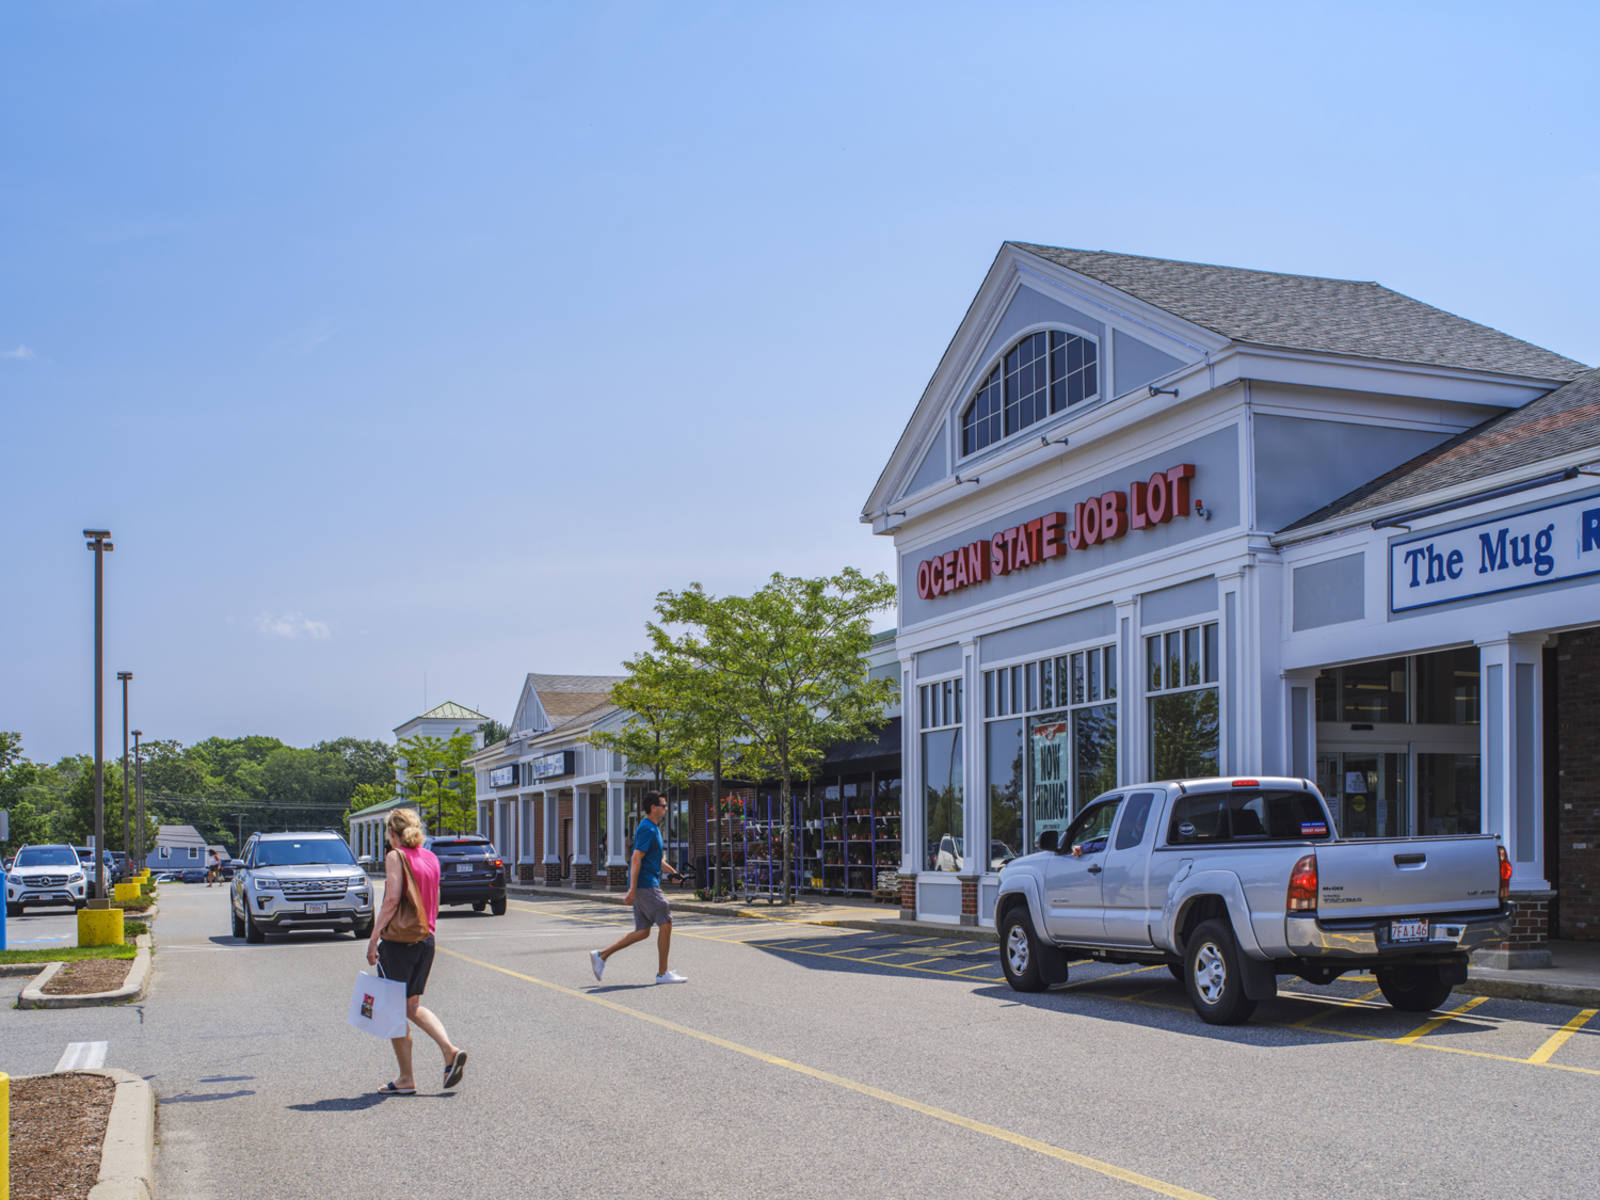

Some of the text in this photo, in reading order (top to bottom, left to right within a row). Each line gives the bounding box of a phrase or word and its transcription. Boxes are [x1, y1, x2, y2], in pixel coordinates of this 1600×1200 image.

[917, 463, 1196, 600] OCEAN STATE JOB LOT
[1404, 543, 1463, 588] The
[1479, 524, 1555, 576] Mug
[1040, 744, 1061, 781] NOW
[1035, 780, 1068, 821] HIRING!
